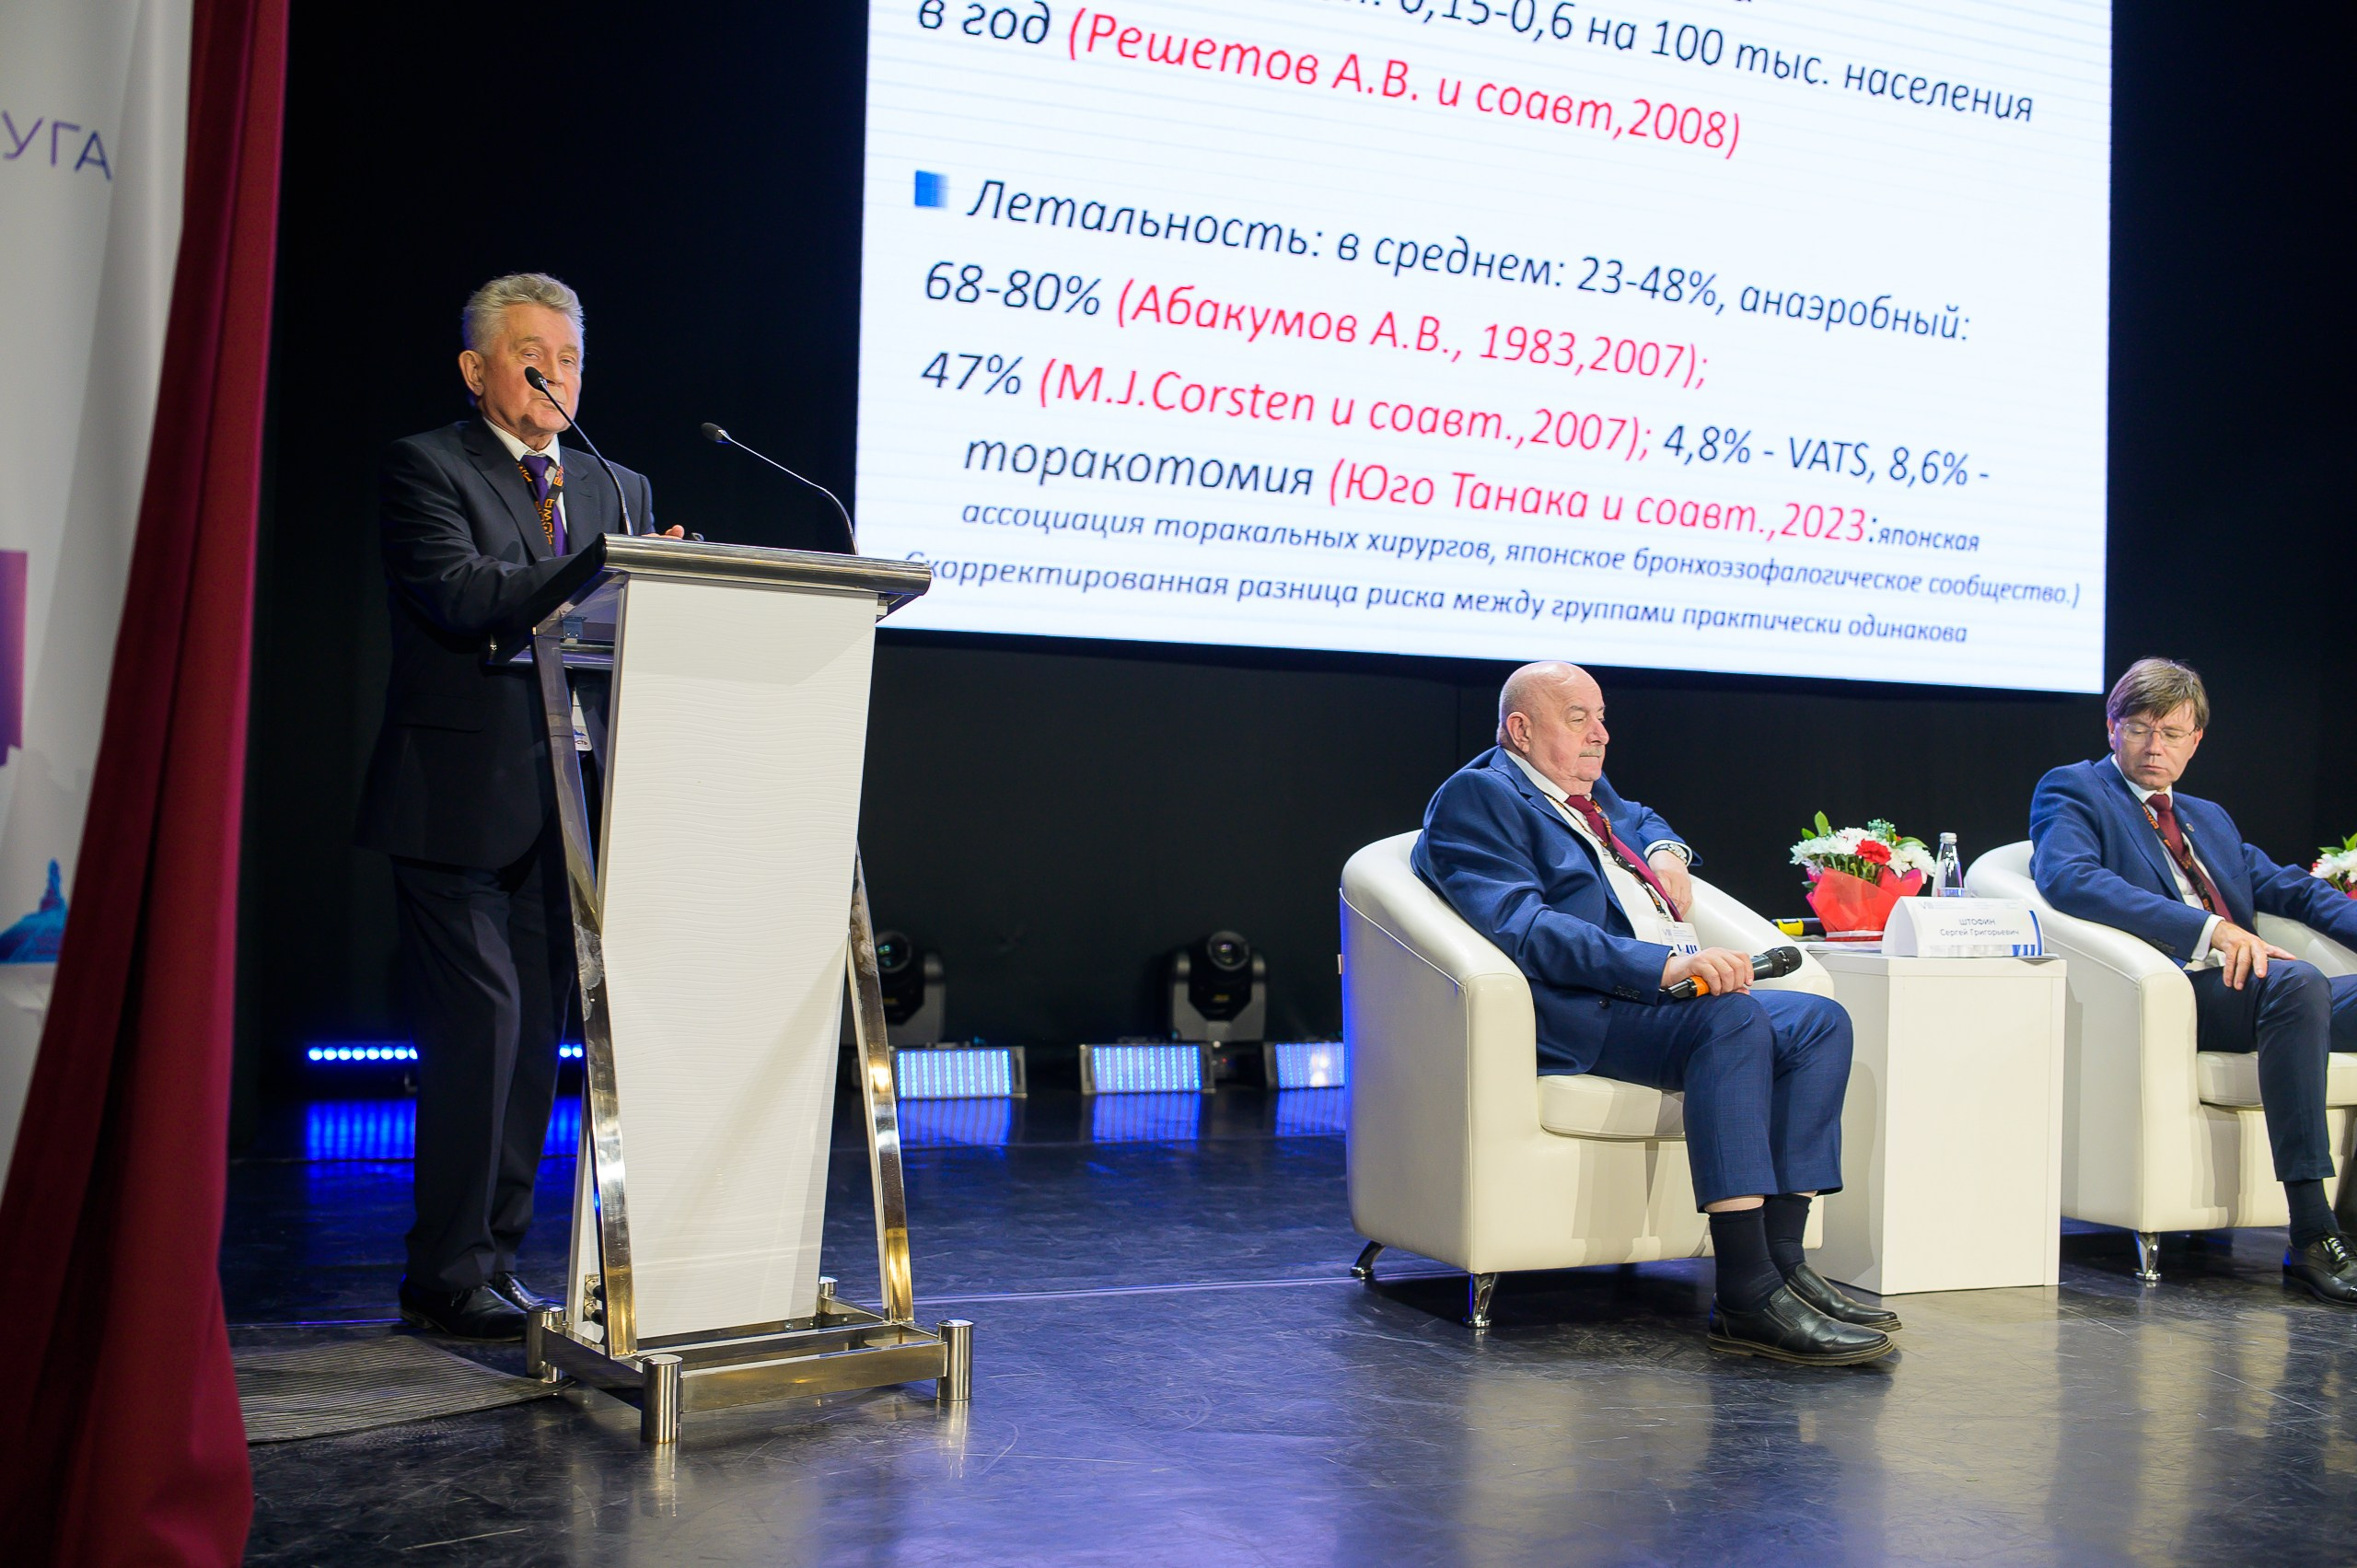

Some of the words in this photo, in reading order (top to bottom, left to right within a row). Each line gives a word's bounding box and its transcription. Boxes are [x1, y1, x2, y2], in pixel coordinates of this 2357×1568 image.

[916, 0, 947, 31] в
[960, 0, 1052, 46] год
[1067, 6, 1320, 87] (Решетов
[1436, 76, 1463, 109] и
[1474, 81, 1741, 161] соавт,2008)
[1585, 16, 1639, 52] на
[1649, 18, 1724, 67] 100
[1734, 42, 1829, 87] тыс.
[1842, 63, 2034, 123] населения
[965, 178, 1324, 259] Летальность:
[1335, 231, 1361, 263] в
[1372, 234, 1566, 288] среднем:
[1575, 255, 1726, 317] 23-48%,
[1738, 285, 1970, 342] анаэробный:
[923, 260, 1103, 318] 68-80%
[1116, 276, 1359, 344] (Абакумов
[1478, 322, 1709, 391] 1983,2007);
[919, 351, 1025, 396] 47%
[1329, 396, 1356, 428] и
[1367, 400, 1653, 462] соавт.,2007);
[1662, 424, 1753, 467] 4,8%
[1788, 436, 1876, 485] VATS,
[1887, 445, 1969, 489] 8,6%
[963, 439, 1315, 497] торакотомия
[1328, 457, 1436, 508] (Юго
[1450, 470, 1590, 519] Танака
[1601, 494, 1625, 523] и
[960, 504, 1146, 540] ассоциация
[1153, 517, 1361, 551] торакальных
[1364, 532, 1497, 566] хирургов,
[1504, 543, 1627, 570] японское
[1927, 573, 2081, 610] сообщество.)
[1236, 578, 1359, 610] разница
[1364, 587, 1446, 611] риска
[1451, 587, 1546, 621] между
[1550, 598, 1677, 624] группами
[1681, 607, 1842, 635] практически
[1847, 612, 1968, 644] одинакова
